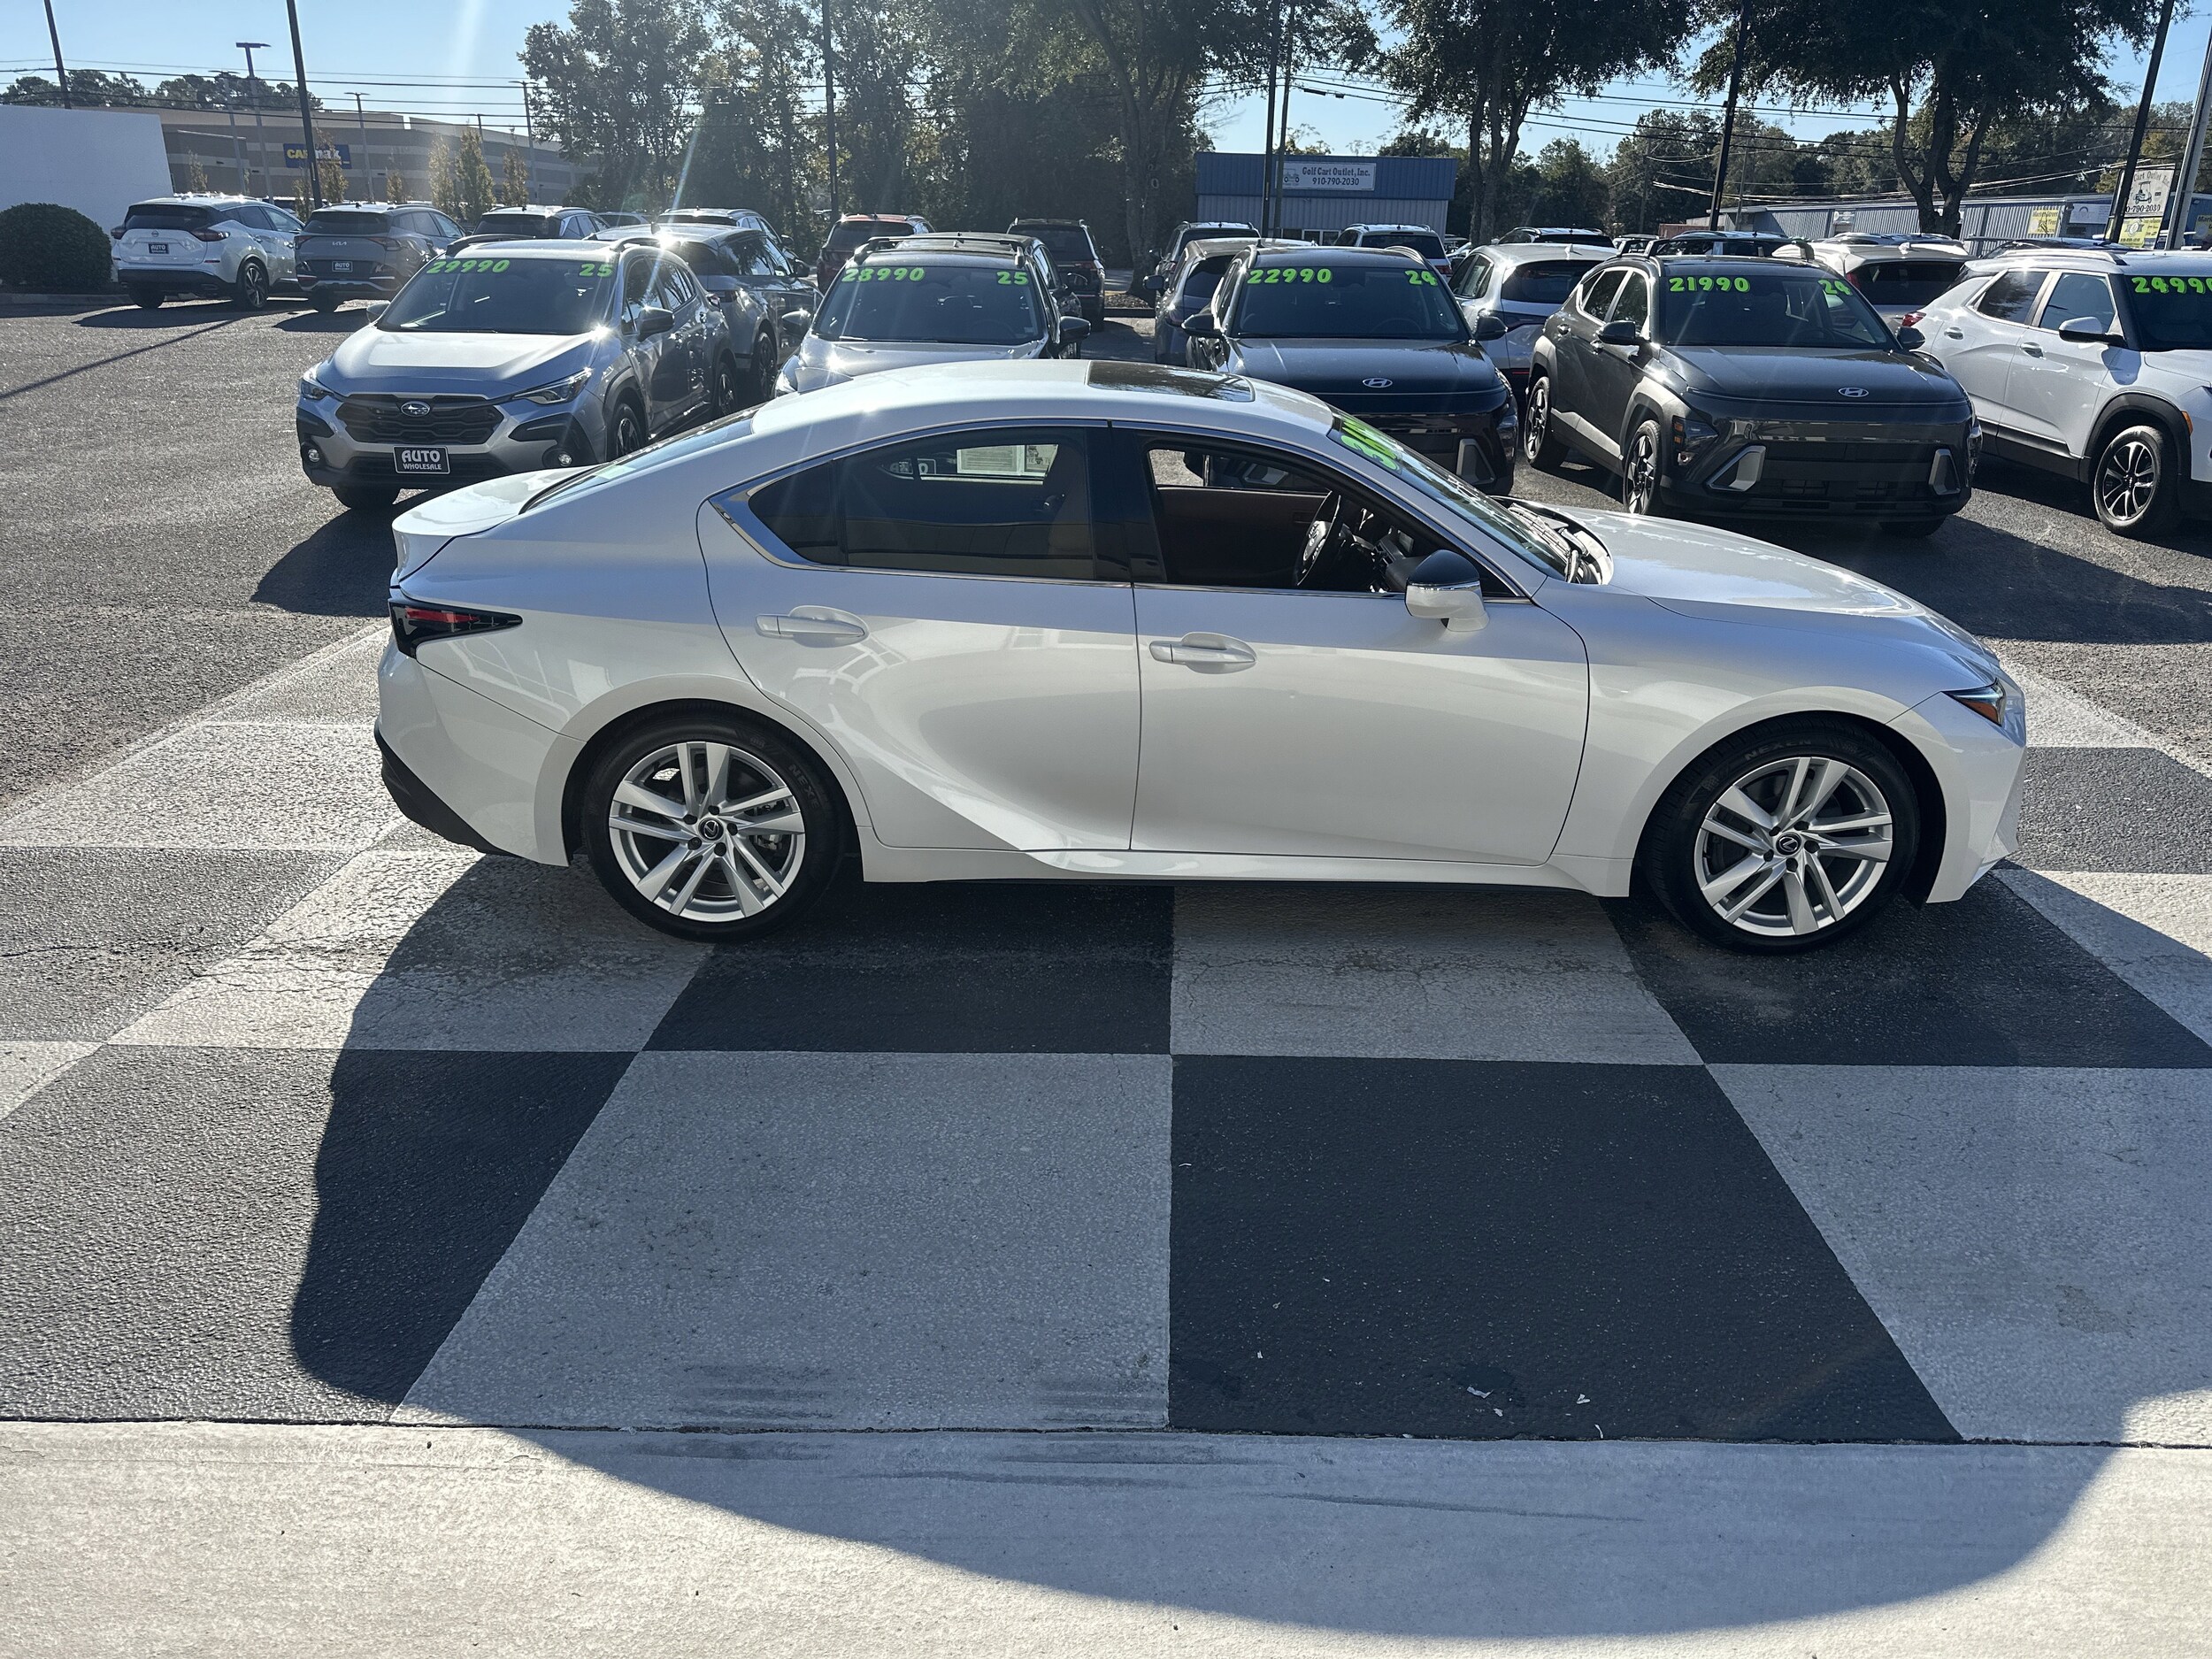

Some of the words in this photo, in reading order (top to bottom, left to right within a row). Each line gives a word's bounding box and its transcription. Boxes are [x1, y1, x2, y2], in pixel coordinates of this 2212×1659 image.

[1302, 166, 1317, 176] Golf
[1317, 167, 1332, 176] Cart
[1357, 167, 1371, 176] Inc.
[1312, 177, 1360, 186] 910-790-2030
[426, 258, 511, 274] 29990
[579, 263, 613, 277] 25
[841, 266, 926, 282] 28990
[996, 270, 1030, 286] 25
[1247, 268, 1333, 284] 22990
[1404, 270, 1439, 287] 24
[1669, 276, 1751, 293] 21990
[1817, 279, 1855, 296] 24
[401, 449, 441, 463] AUTO
[788, 764, 820, 807] NEXE
